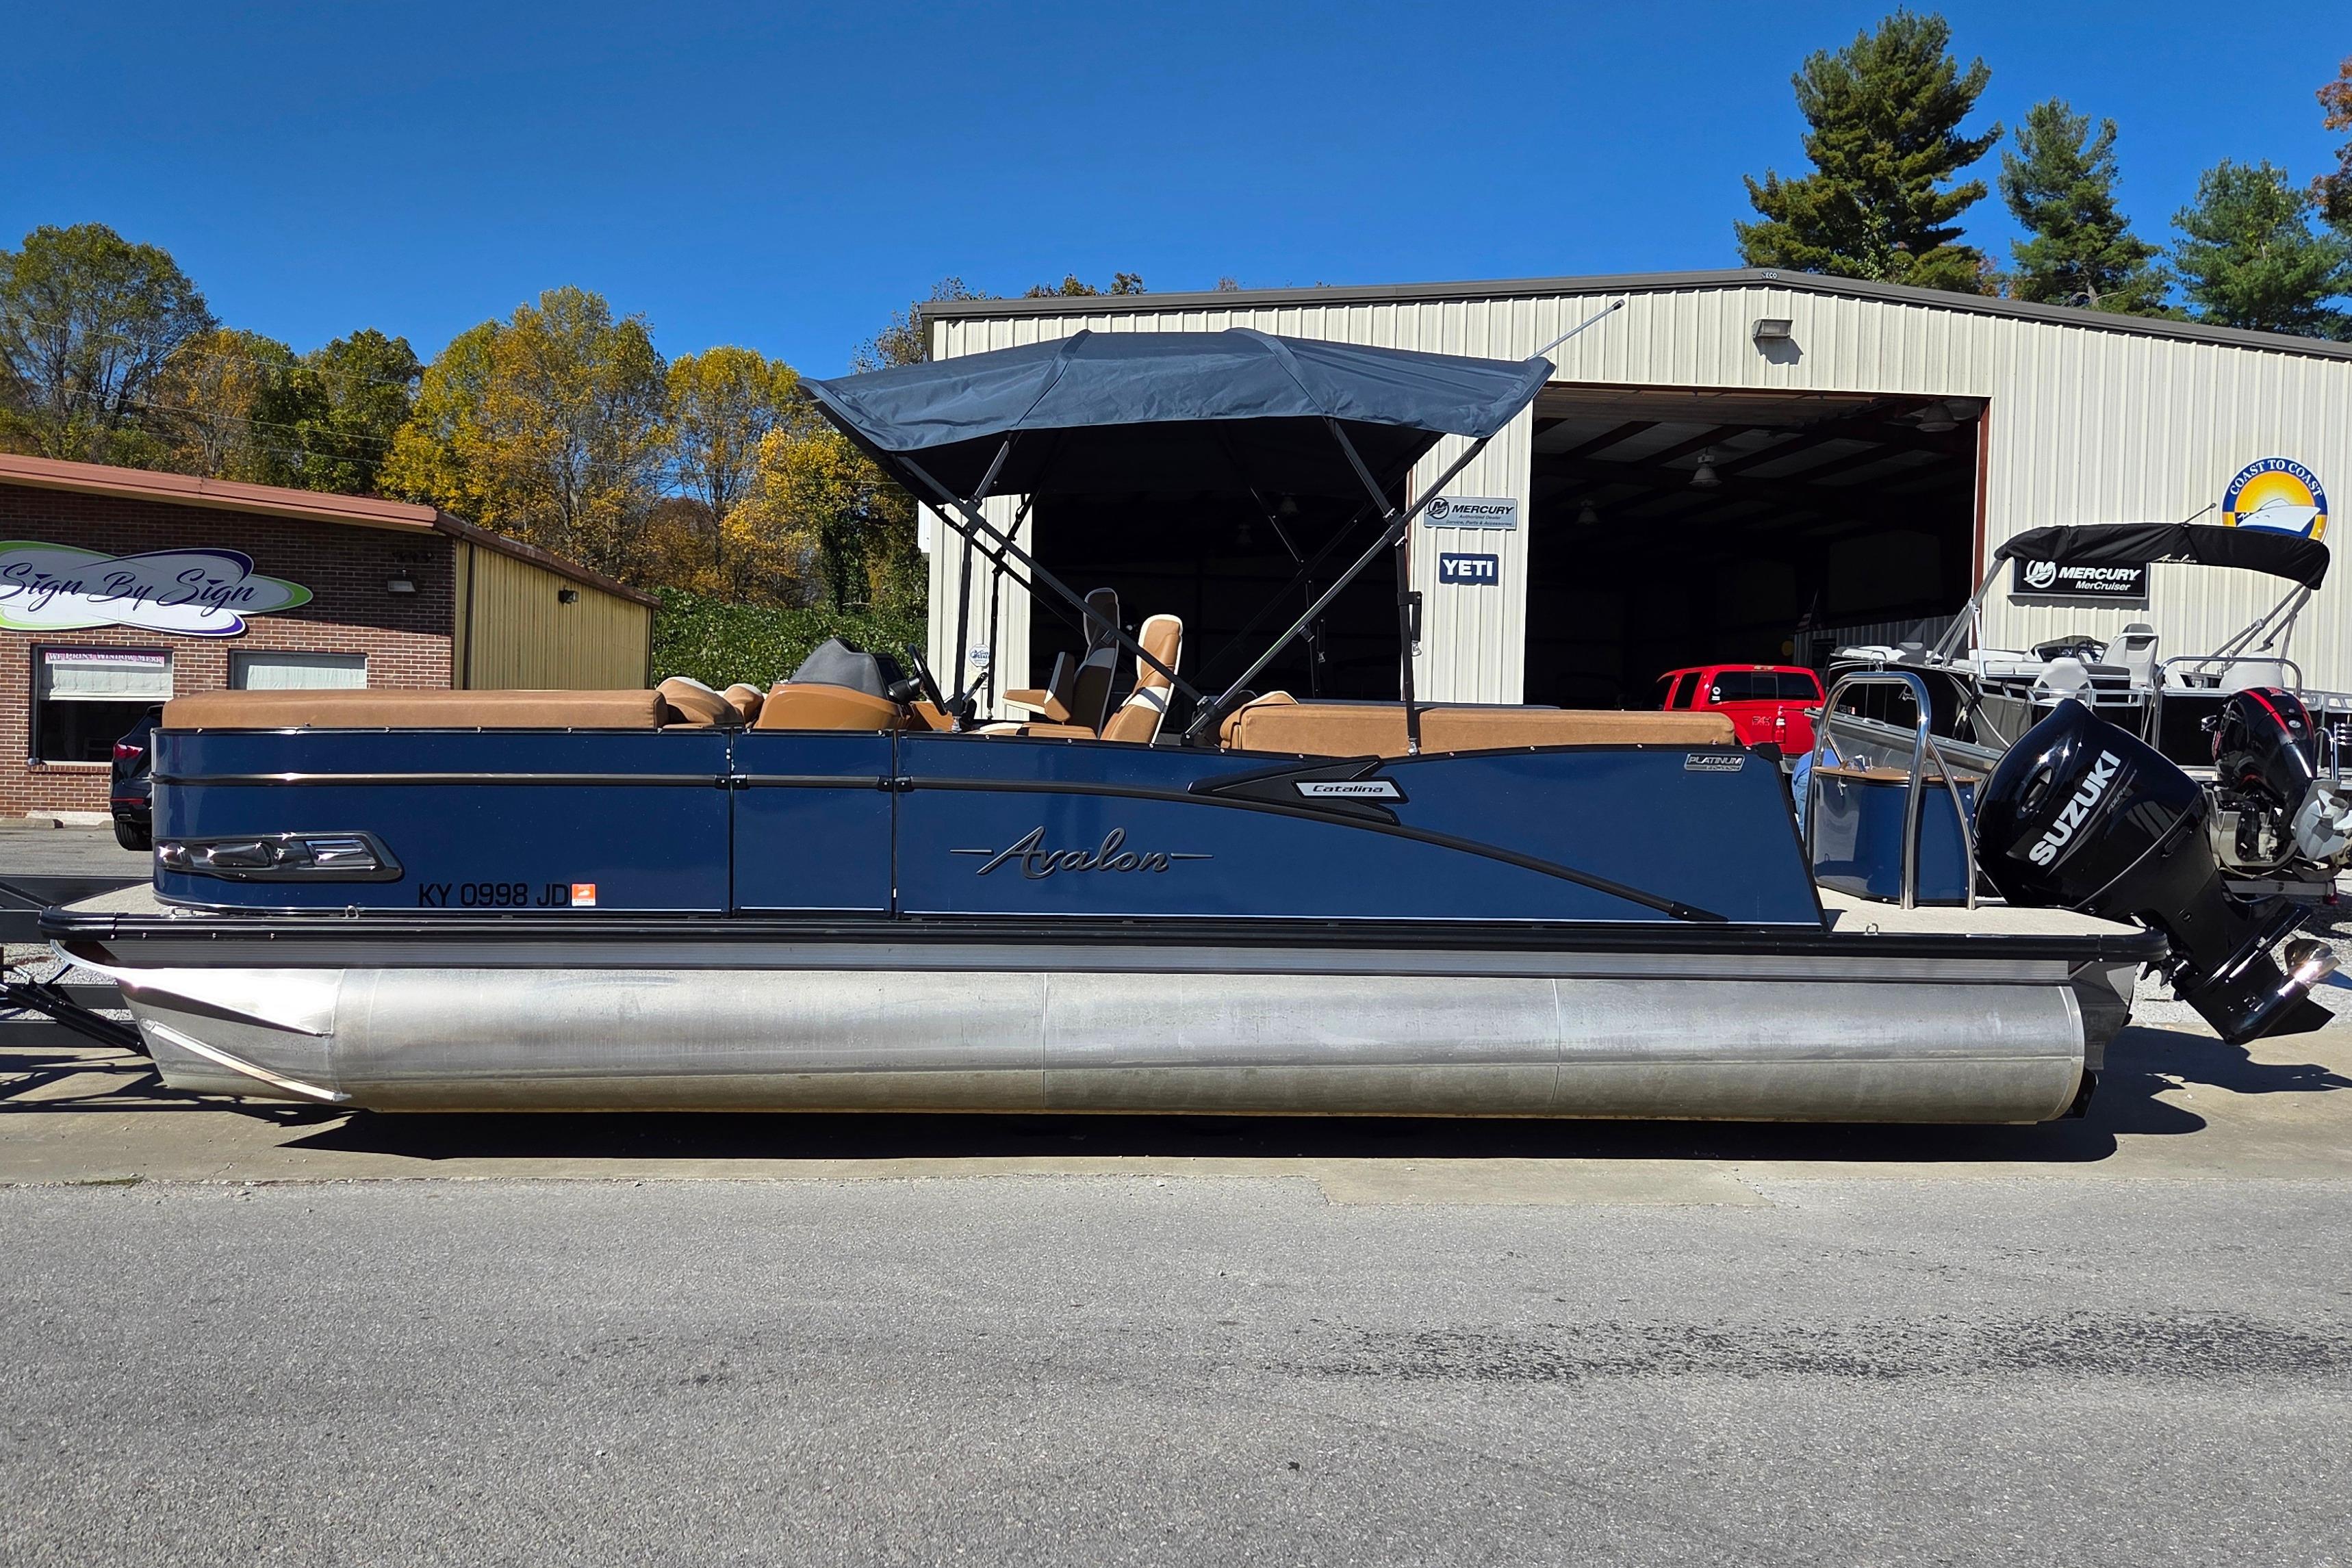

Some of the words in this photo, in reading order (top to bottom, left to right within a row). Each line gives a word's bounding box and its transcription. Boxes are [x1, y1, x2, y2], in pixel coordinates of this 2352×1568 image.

[2230, 462, 2264, 495] COAST
[2268, 459, 2286, 470] TO
[2288, 463, 2322, 496] COAST
[1452, 504, 1514, 515] MERCURY
[2152, 554, 2197, 563] Avalon
[1442, 558, 1494, 577] YETI
[2058, 567, 2142, 580] MERCURY
[0, 562, 84, 613] Sign
[87, 571, 154, 611] By
[156, 568, 258, 617] Sign
[2075, 580, 2131, 591] MerCruiser
[64, 652, 94, 660] PRINT
[97, 653, 134, 662] WINDOW
[1688, 756, 1743, 764] PLATINUM
[2029, 749, 2121, 866] SUZUKI
[976, 825, 1169, 879] Avalon
[418, 883, 453, 907] KY
[460, 883, 528, 907] 0998
[536, 884, 569, 907] JD
